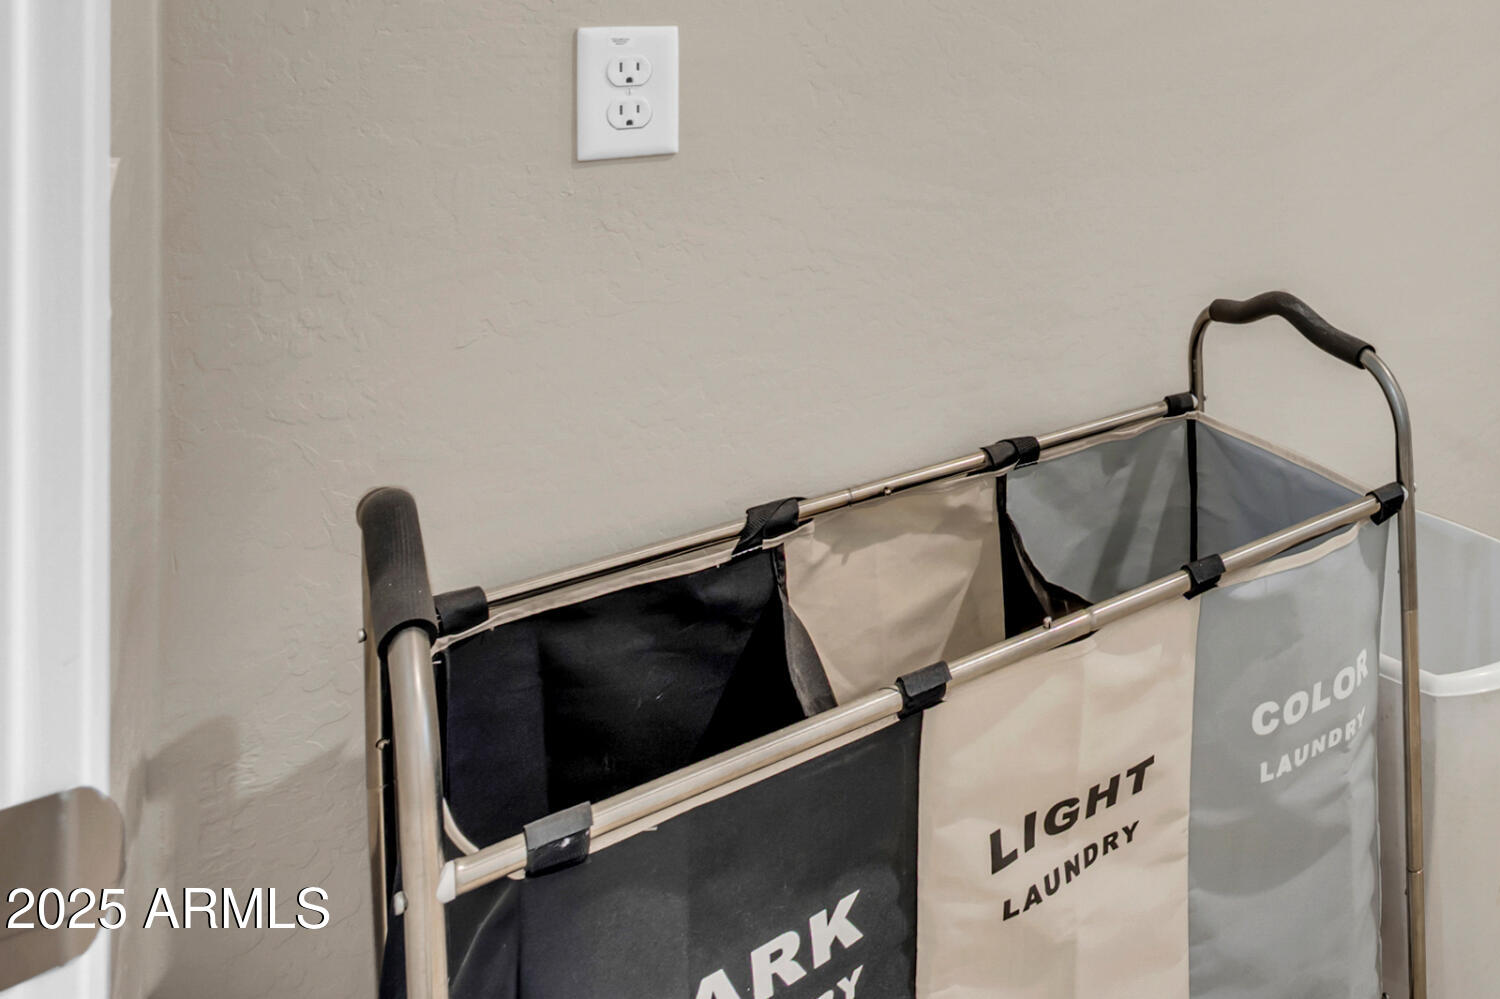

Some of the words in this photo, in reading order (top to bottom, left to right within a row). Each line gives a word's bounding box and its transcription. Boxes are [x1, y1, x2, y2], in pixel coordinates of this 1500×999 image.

[1252, 648, 1368, 735] COLOR
[1260, 705, 1366, 784] LAUNDRY
[990, 755, 1155, 875] LIGHT
[1003, 820, 1140, 921] LAUNDRY
